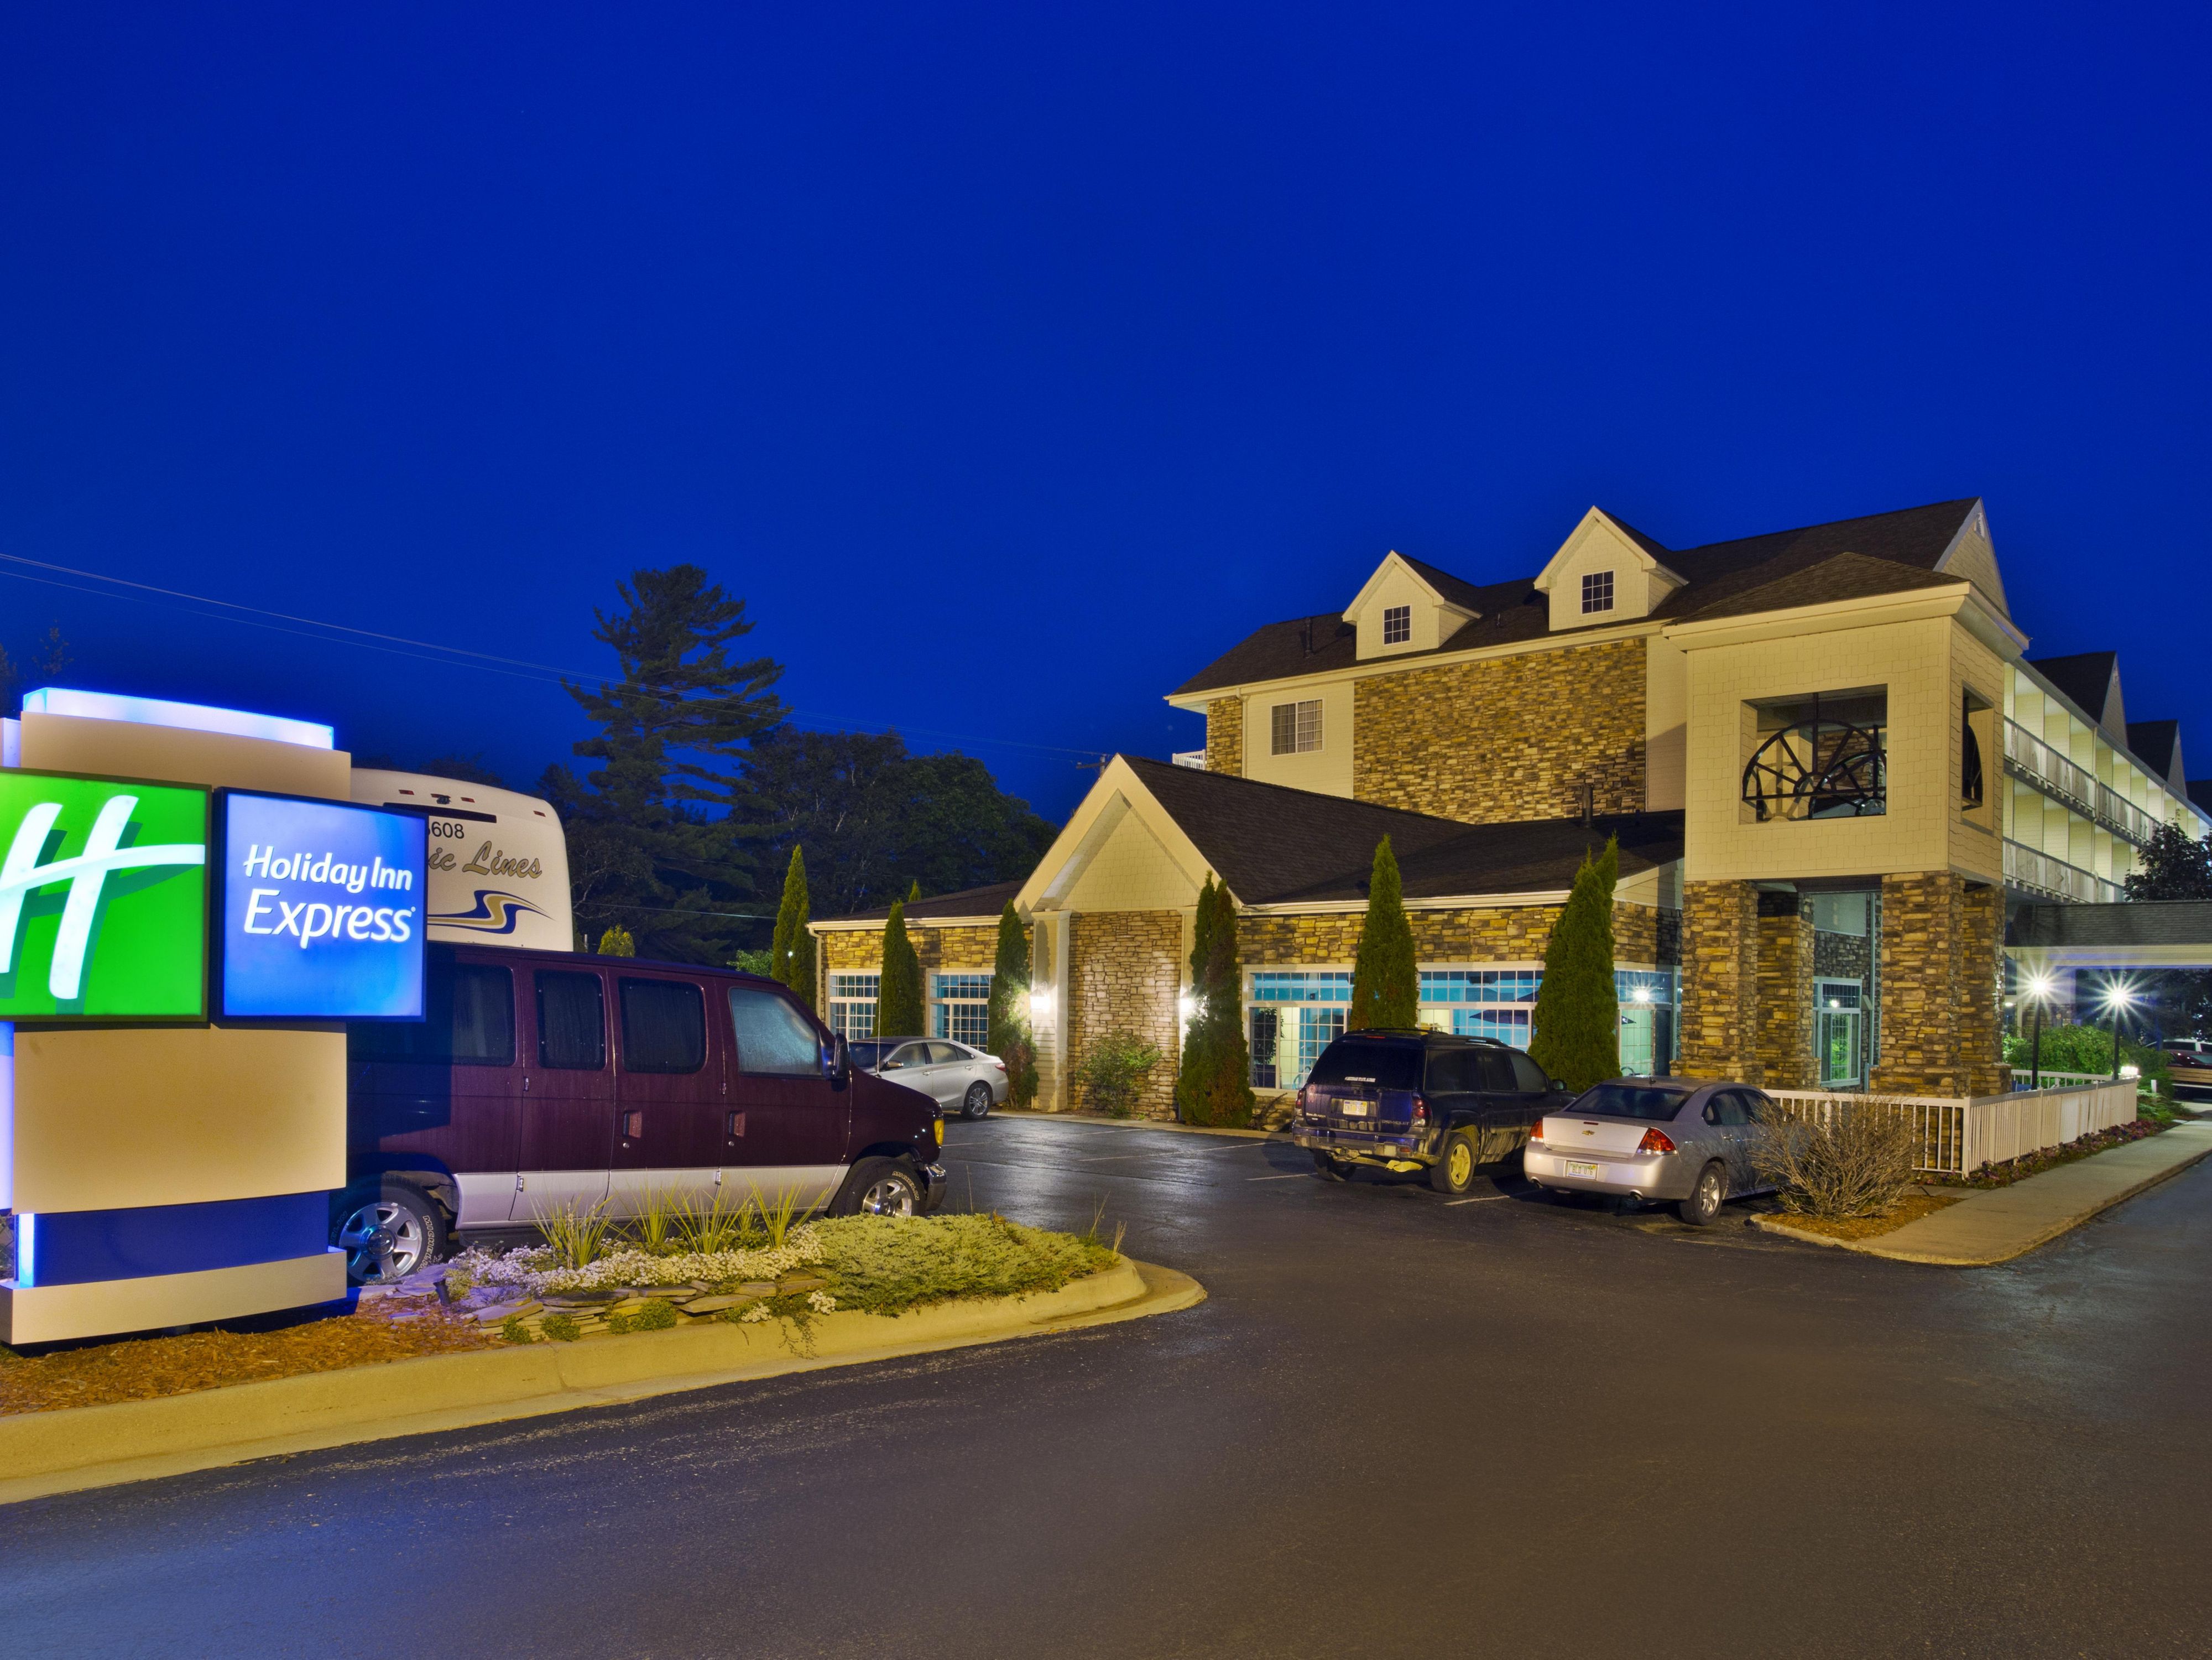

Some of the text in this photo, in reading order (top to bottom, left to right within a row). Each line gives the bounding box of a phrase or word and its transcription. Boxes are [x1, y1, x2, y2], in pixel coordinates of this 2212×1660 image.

[428, 821, 465, 839] 608
[243, 844, 413, 893] Holiday Inn
[428, 841, 542, 878] ic Lines
[244, 888, 413, 949] Express
[891, 1170, 920, 1200] MICHELIN
